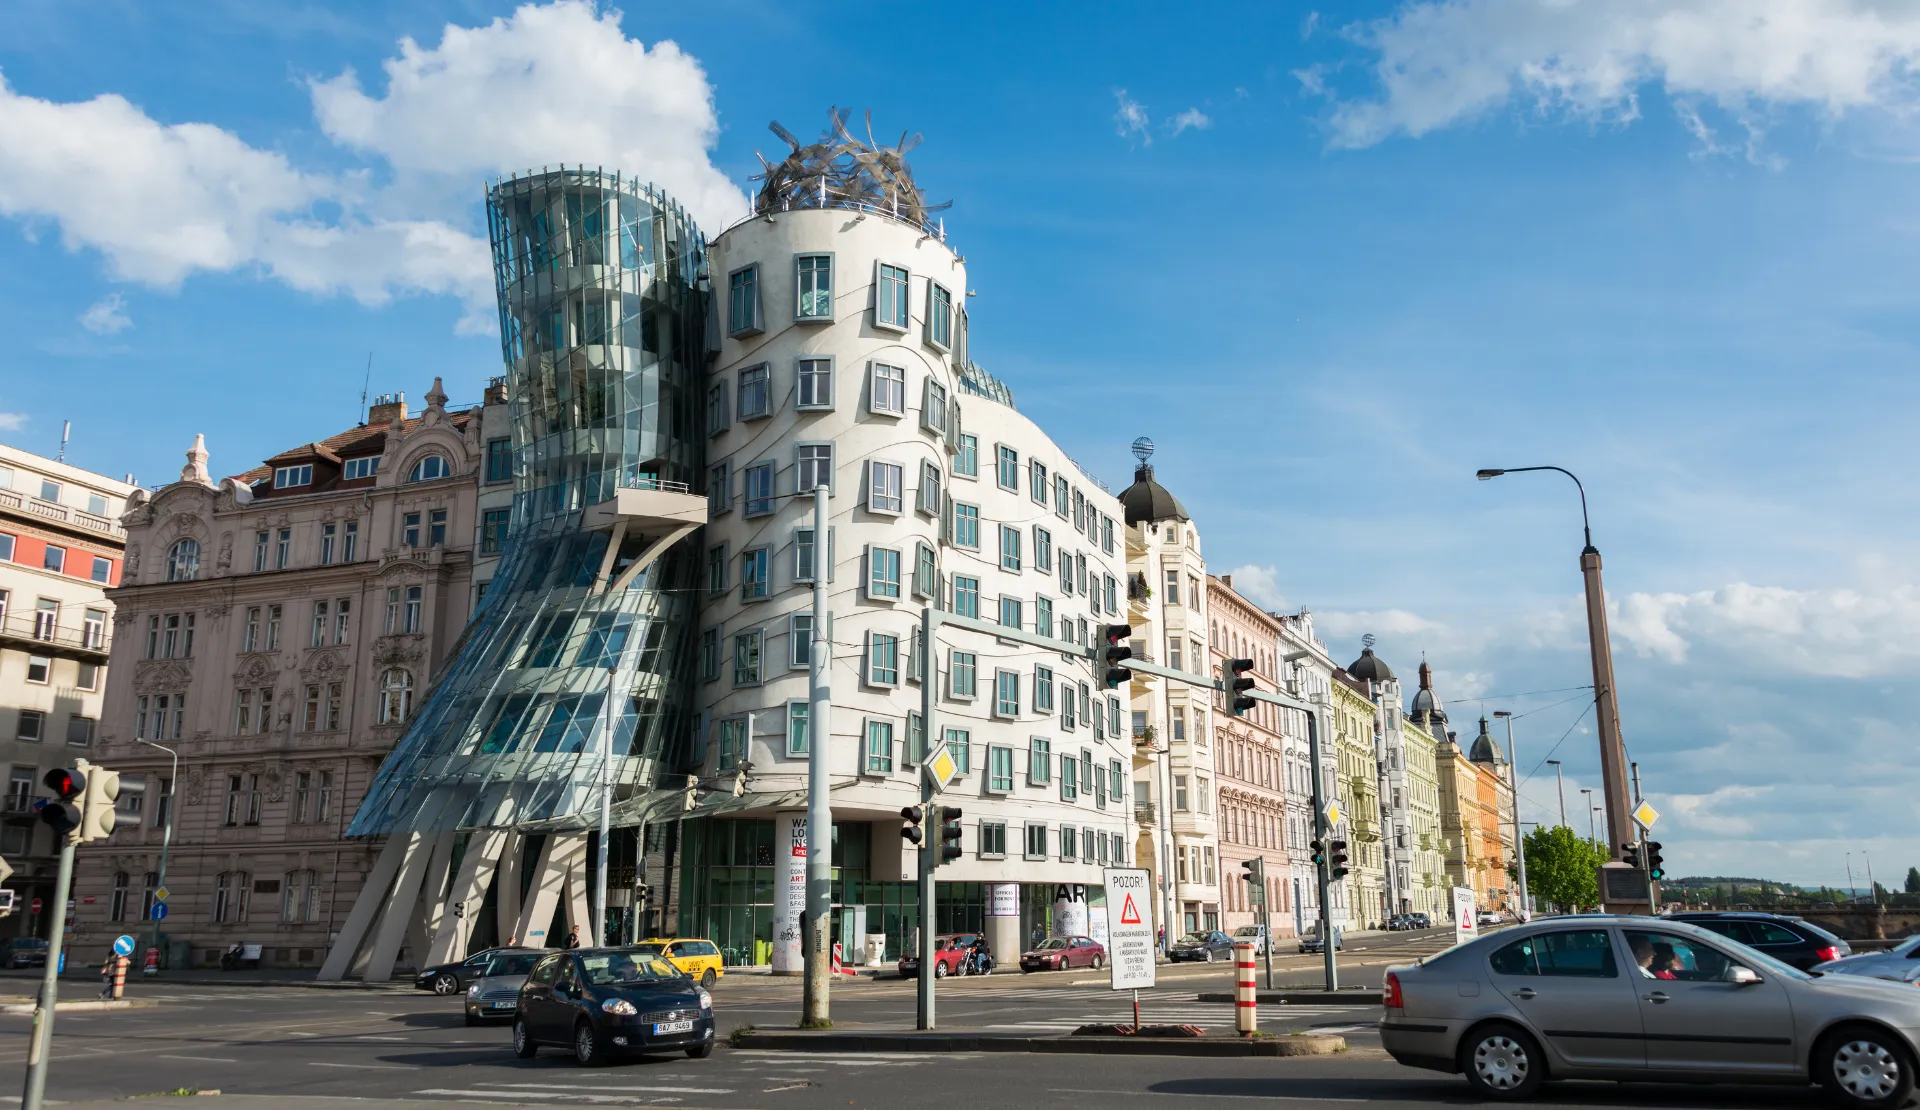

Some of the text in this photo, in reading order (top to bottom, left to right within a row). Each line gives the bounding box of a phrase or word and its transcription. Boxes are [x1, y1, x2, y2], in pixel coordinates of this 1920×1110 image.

[792, 819, 807, 828] WA
[792, 829, 807, 838] LO
[792, 839, 807, 848] INS
[1112, 876, 1144, 888] POZOR!
